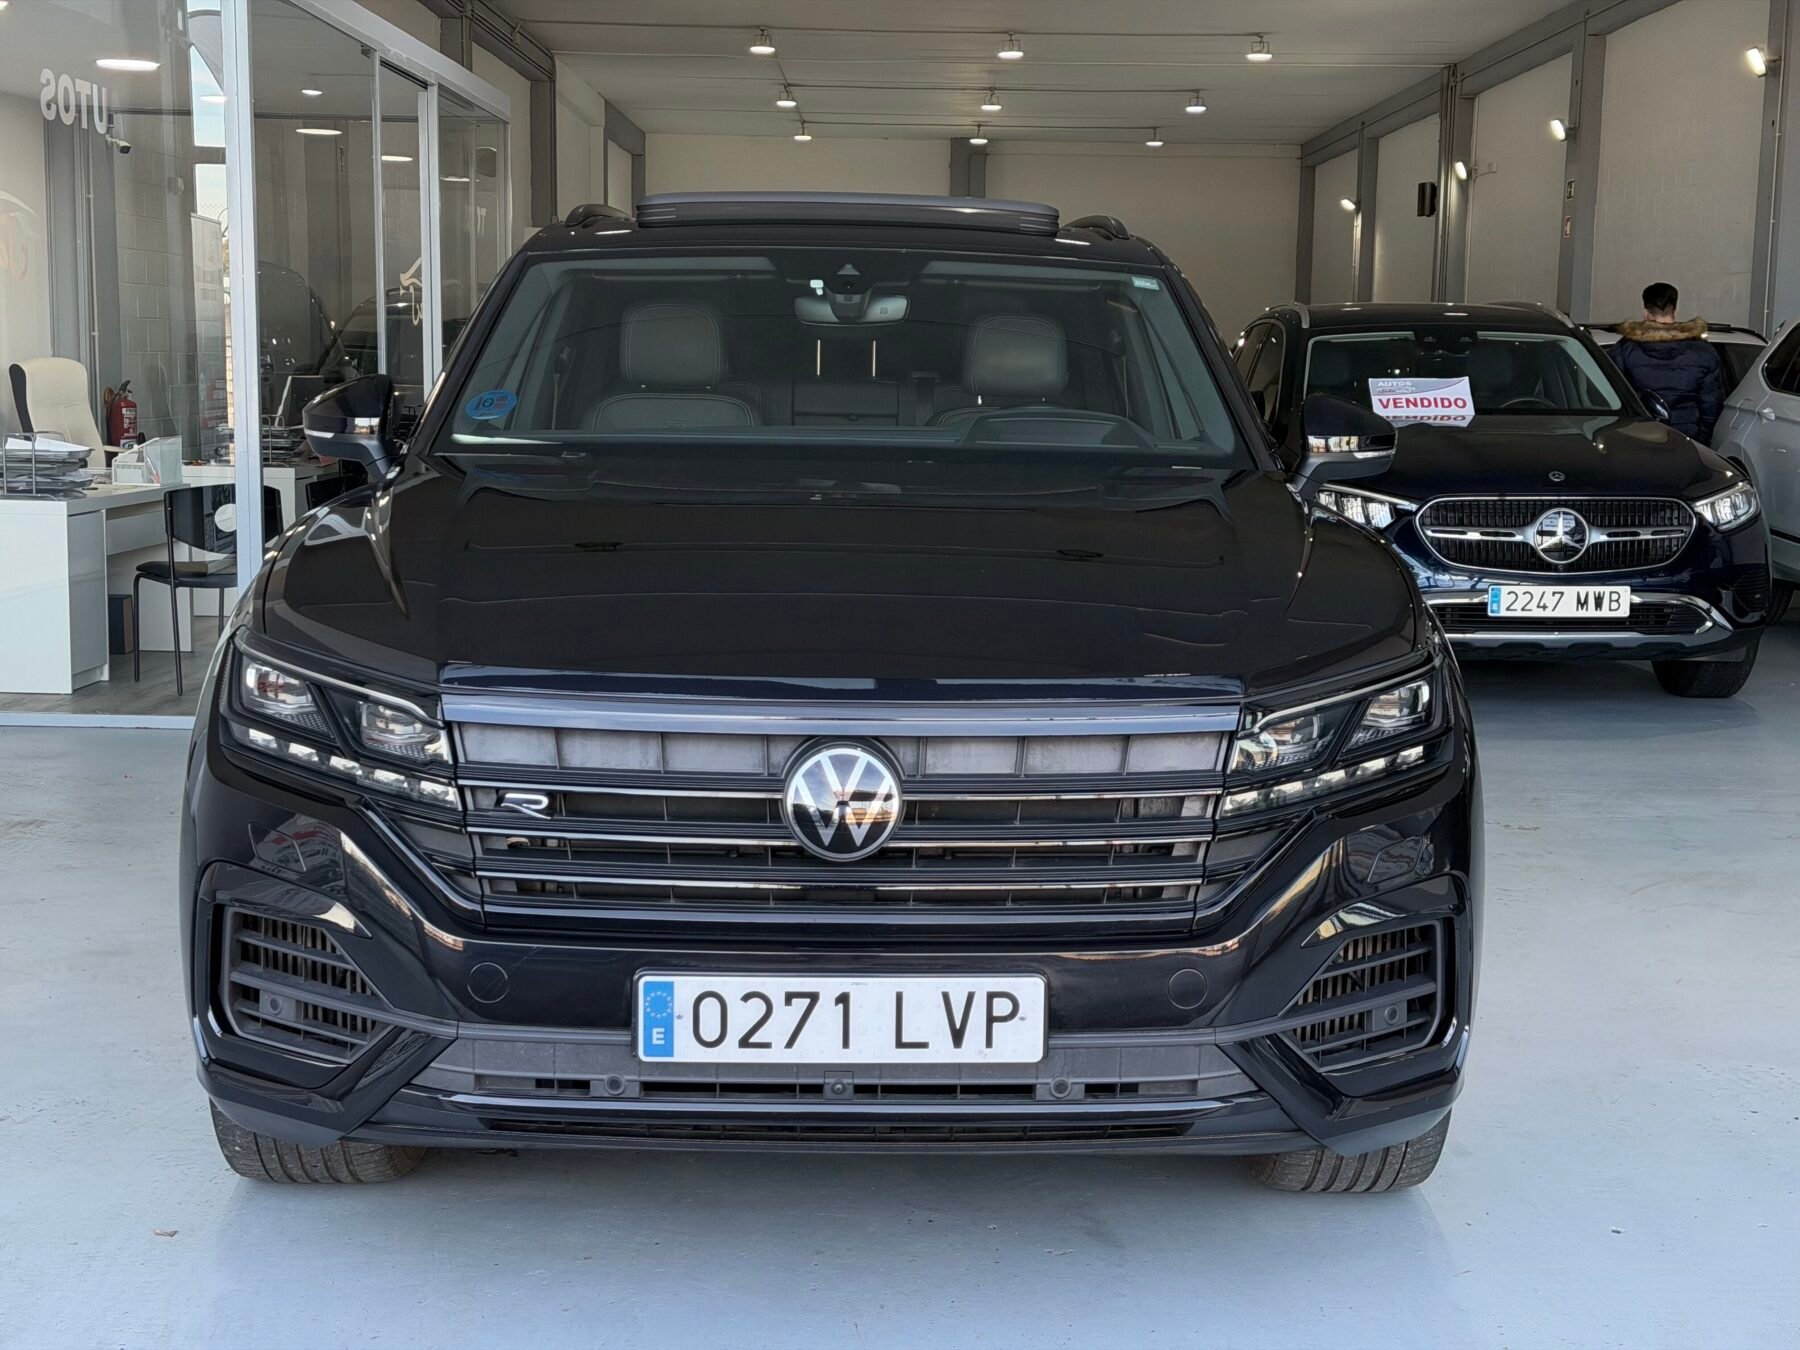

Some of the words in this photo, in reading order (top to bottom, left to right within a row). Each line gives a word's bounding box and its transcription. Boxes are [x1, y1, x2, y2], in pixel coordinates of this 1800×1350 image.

[1378, 397, 1467, 409] VENDIDO
[1505, 591, 1564, 612] 2247
[1576, 591, 1621, 612] MWB
[692, 990, 851, 1049] 0271
[895, 991, 1021, 1049] LVP
[652, 1027, 665, 1045] E
